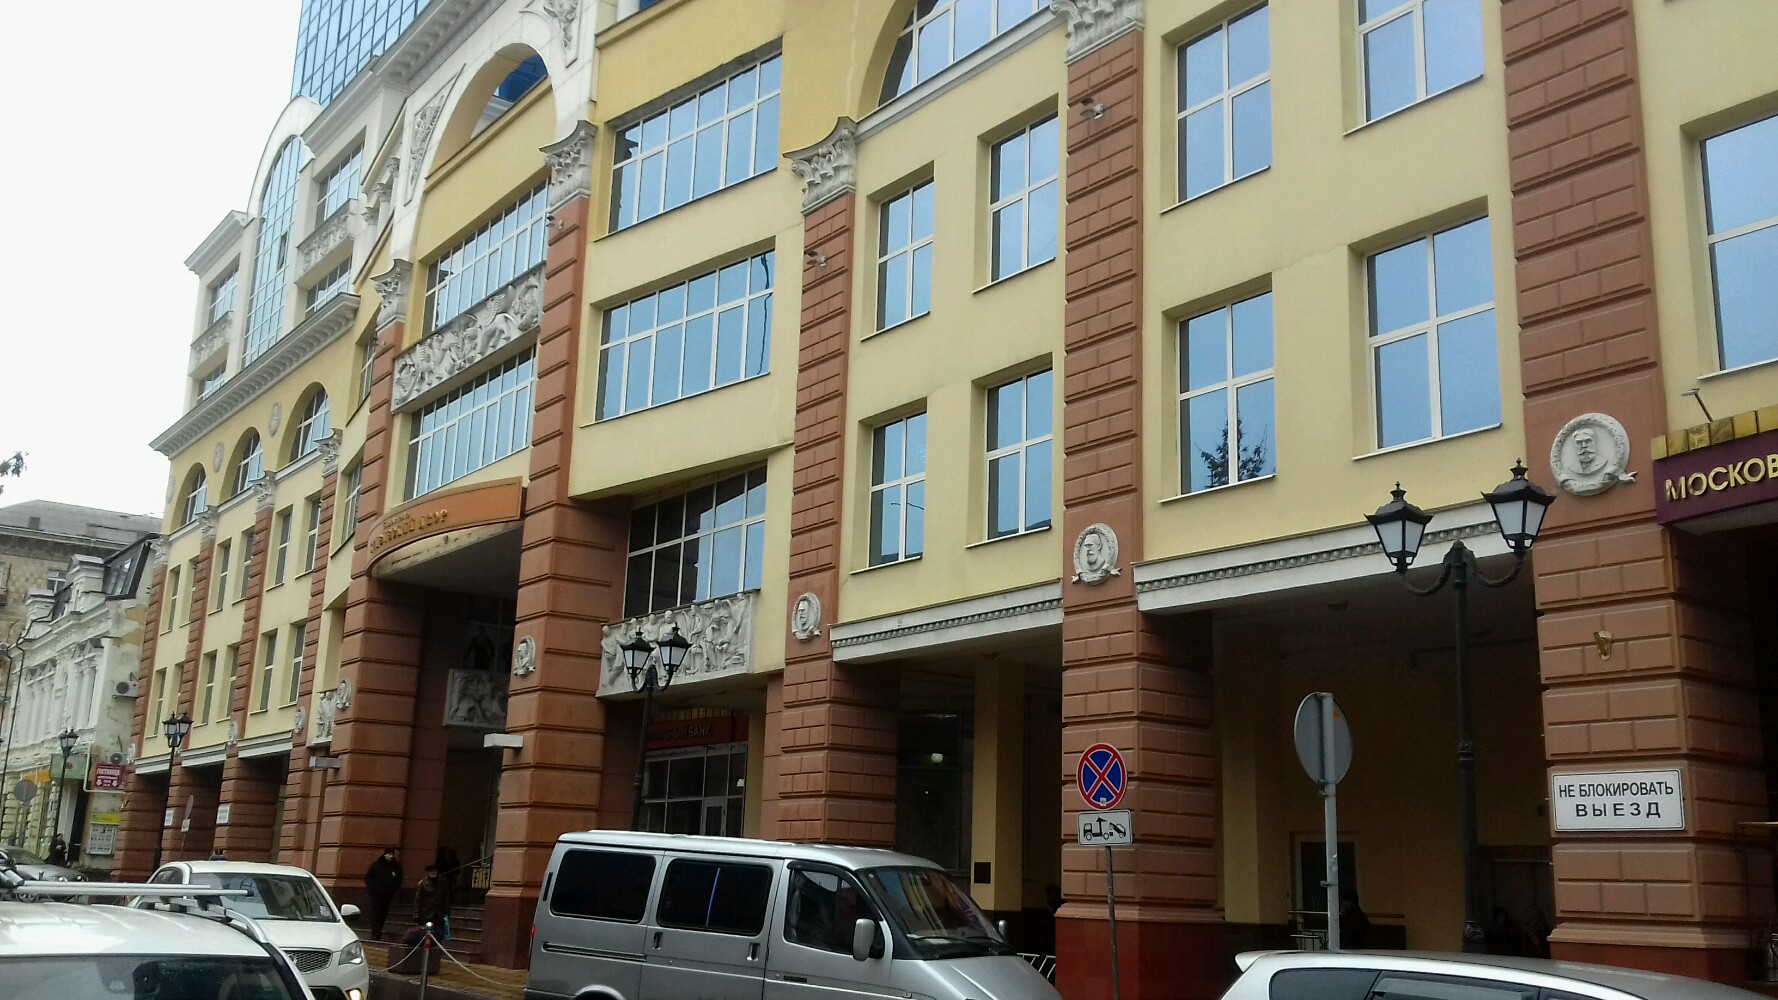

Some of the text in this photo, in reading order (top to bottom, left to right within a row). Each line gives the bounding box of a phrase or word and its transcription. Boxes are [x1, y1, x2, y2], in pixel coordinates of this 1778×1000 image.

[1665, 453, 1778, 502] МОСКОВ
[688, 725, 711, 738] БАНК
[1558, 781, 1674, 798] НЕ БЛОКИРОВАТЬ
[1575, 801, 1661, 818] ВЫЕЗД
